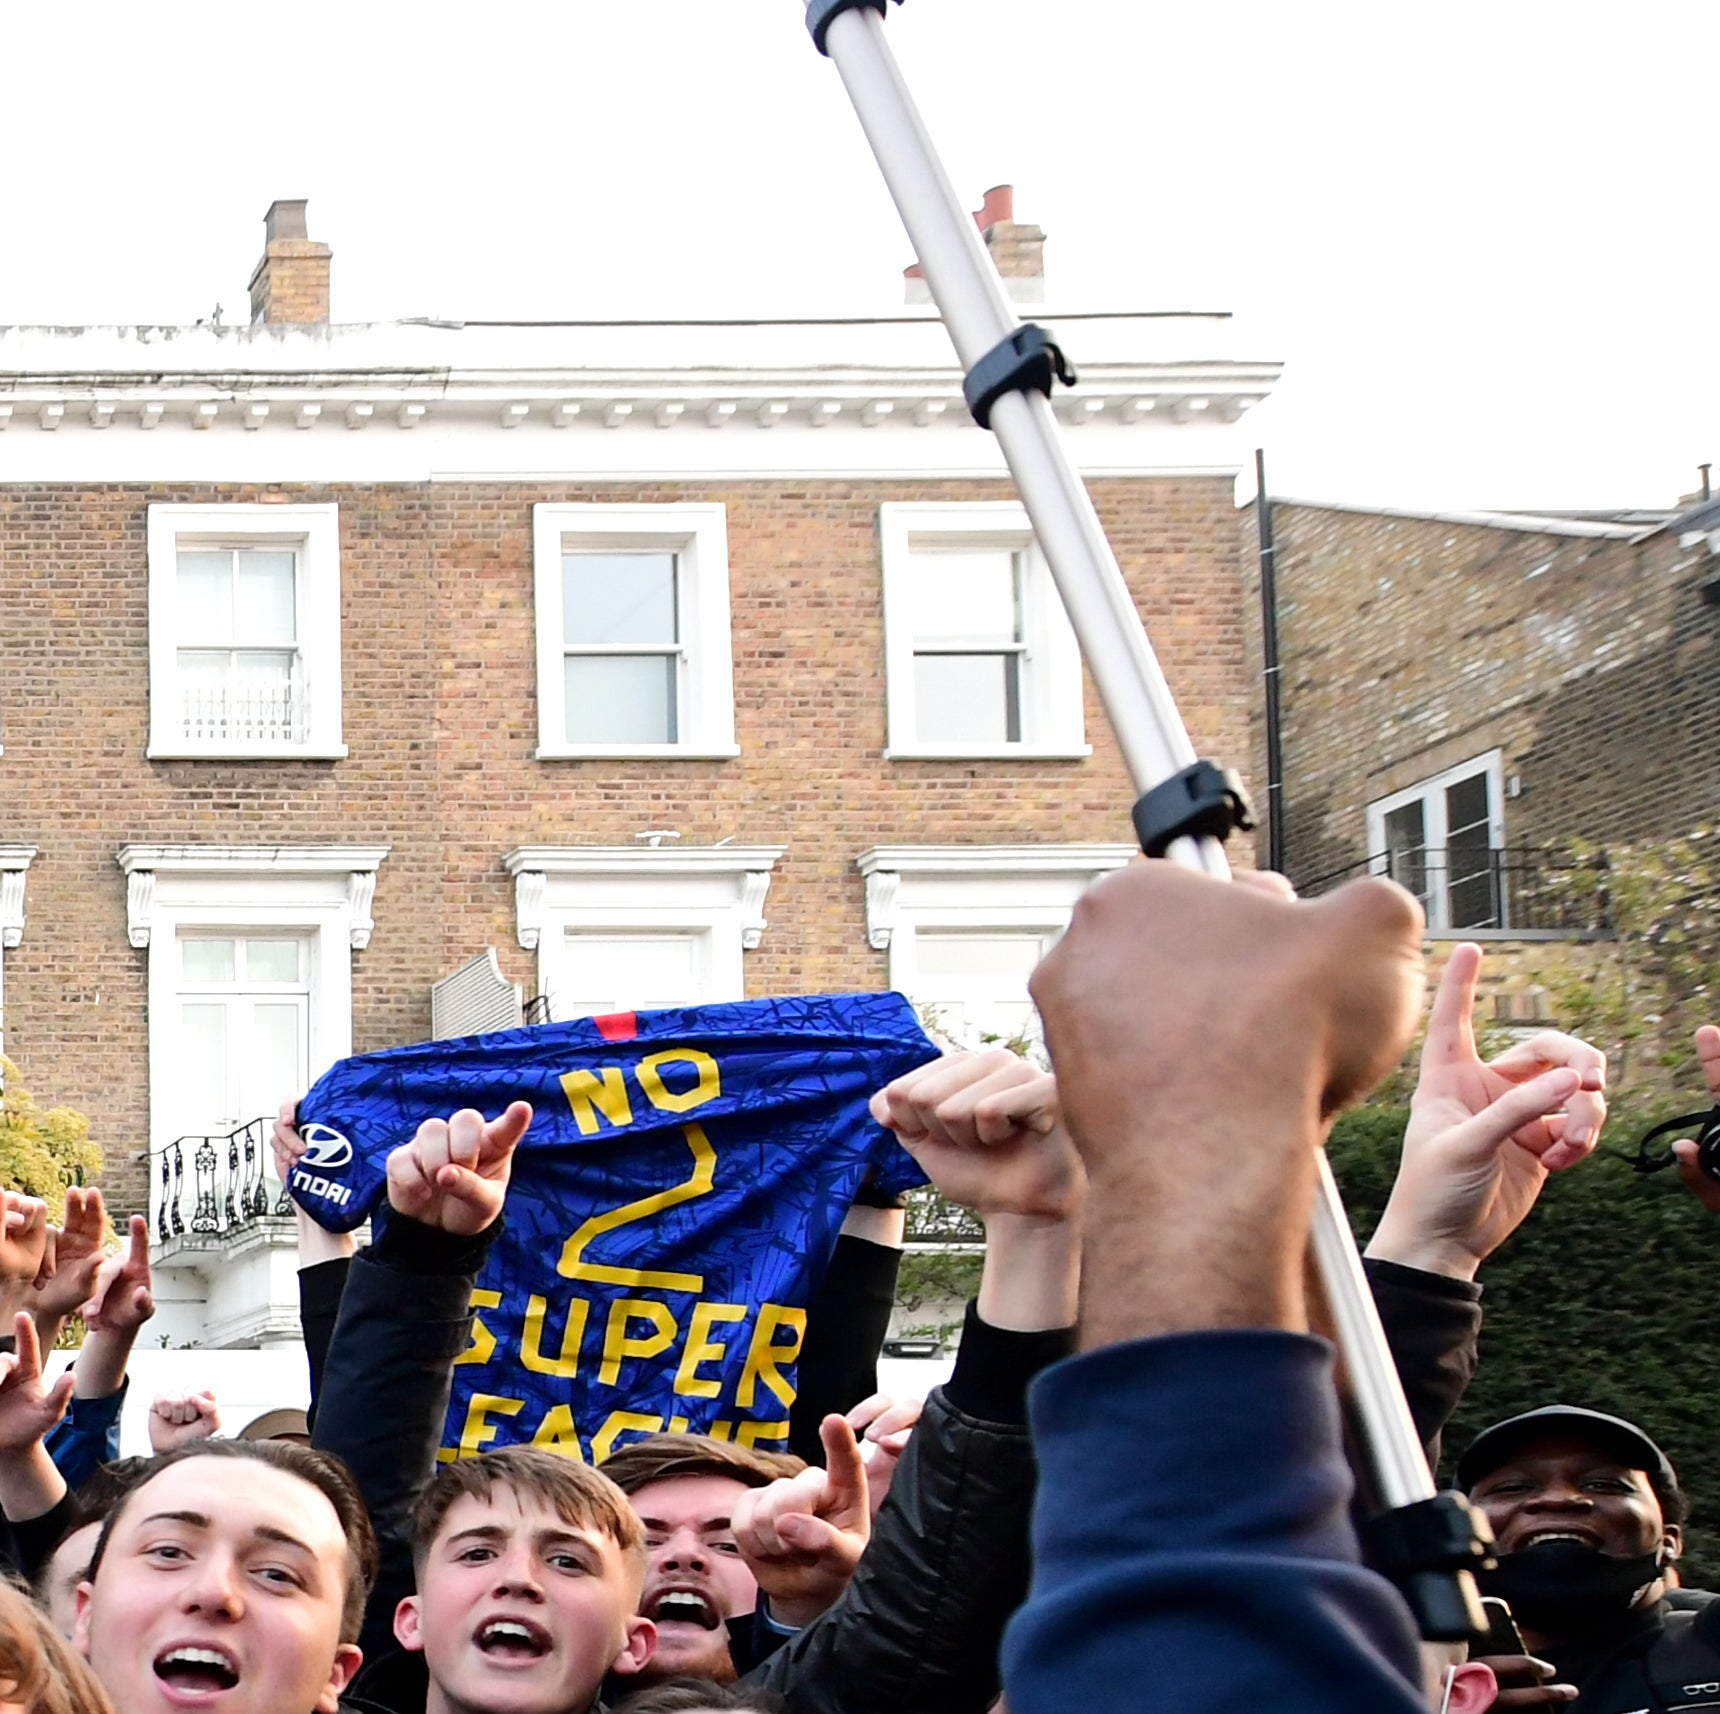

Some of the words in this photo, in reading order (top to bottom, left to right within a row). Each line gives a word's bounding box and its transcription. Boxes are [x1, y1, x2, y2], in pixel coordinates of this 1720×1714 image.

[560, 1047, 720, 1135] NO
[292, 1167, 352, 1206] NDAI
[556, 1123, 716, 1293] 2
[453, 1287, 807, 1409] SUPER
